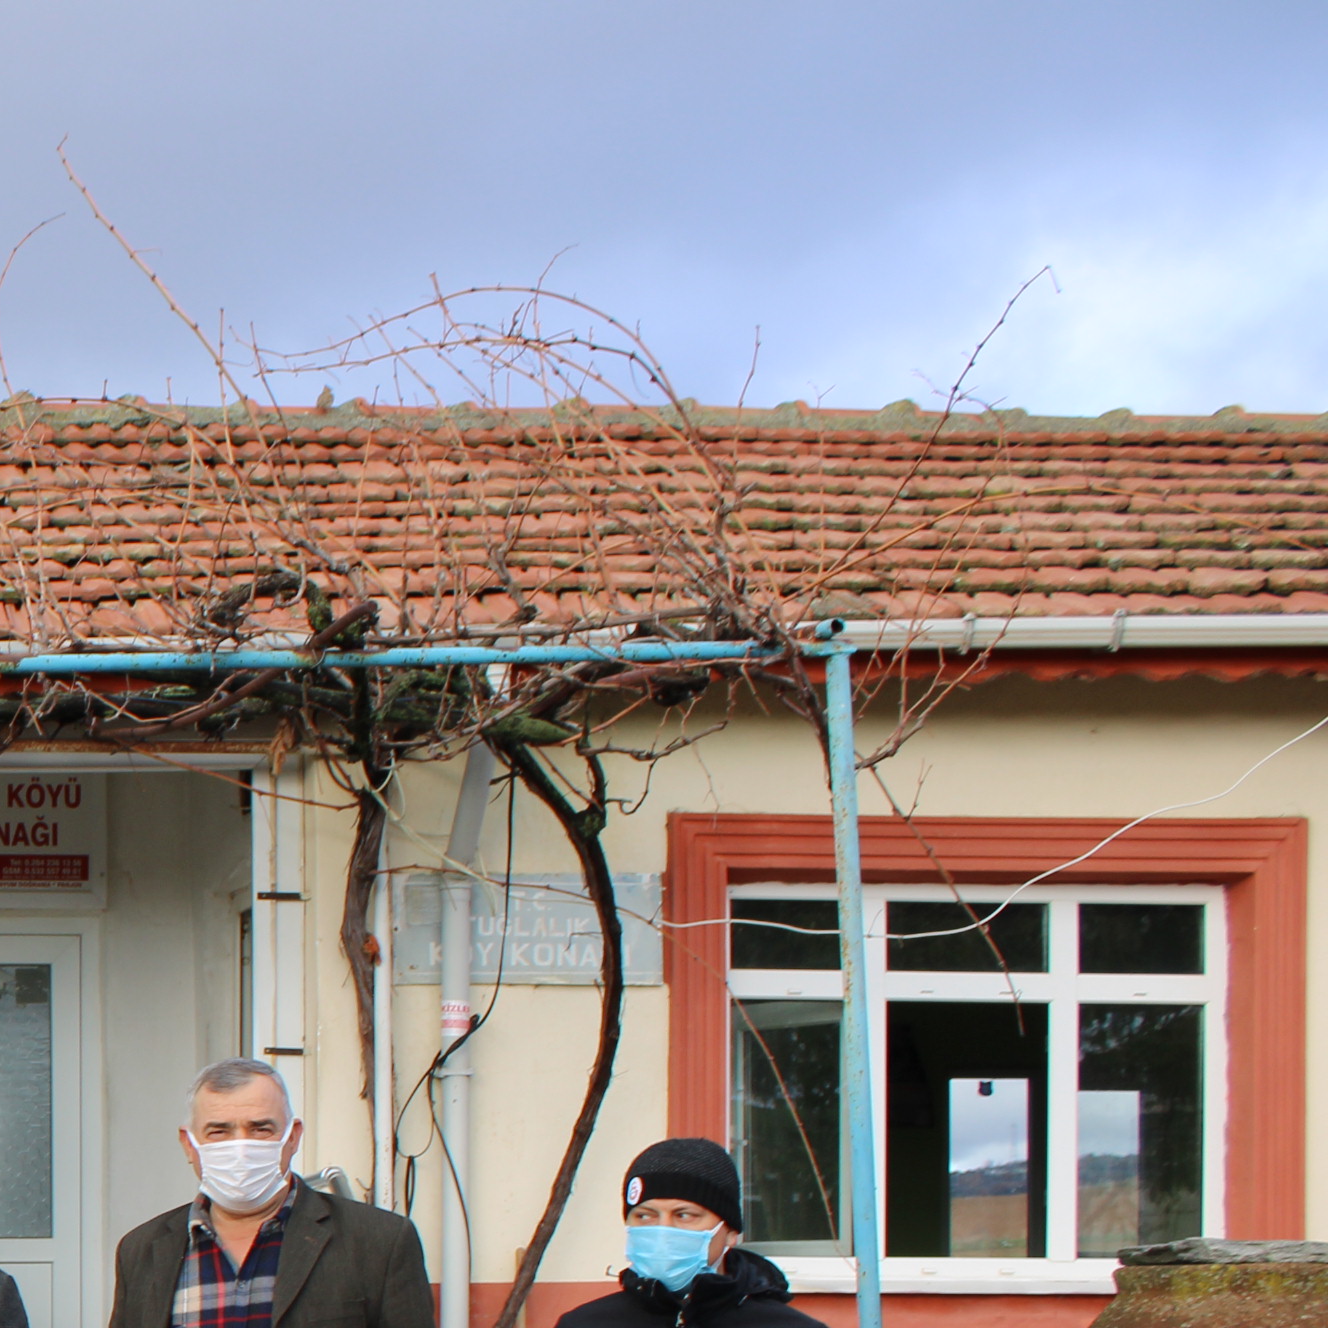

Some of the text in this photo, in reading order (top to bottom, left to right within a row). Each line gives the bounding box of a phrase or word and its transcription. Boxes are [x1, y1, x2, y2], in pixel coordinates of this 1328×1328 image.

[7, 777, 82, 808] KÖYÜ
[509, 890, 552, 911] T.C.
[470, 912, 591, 938] UĞLALIK
[428, 941, 631, 967] KY KONAI
